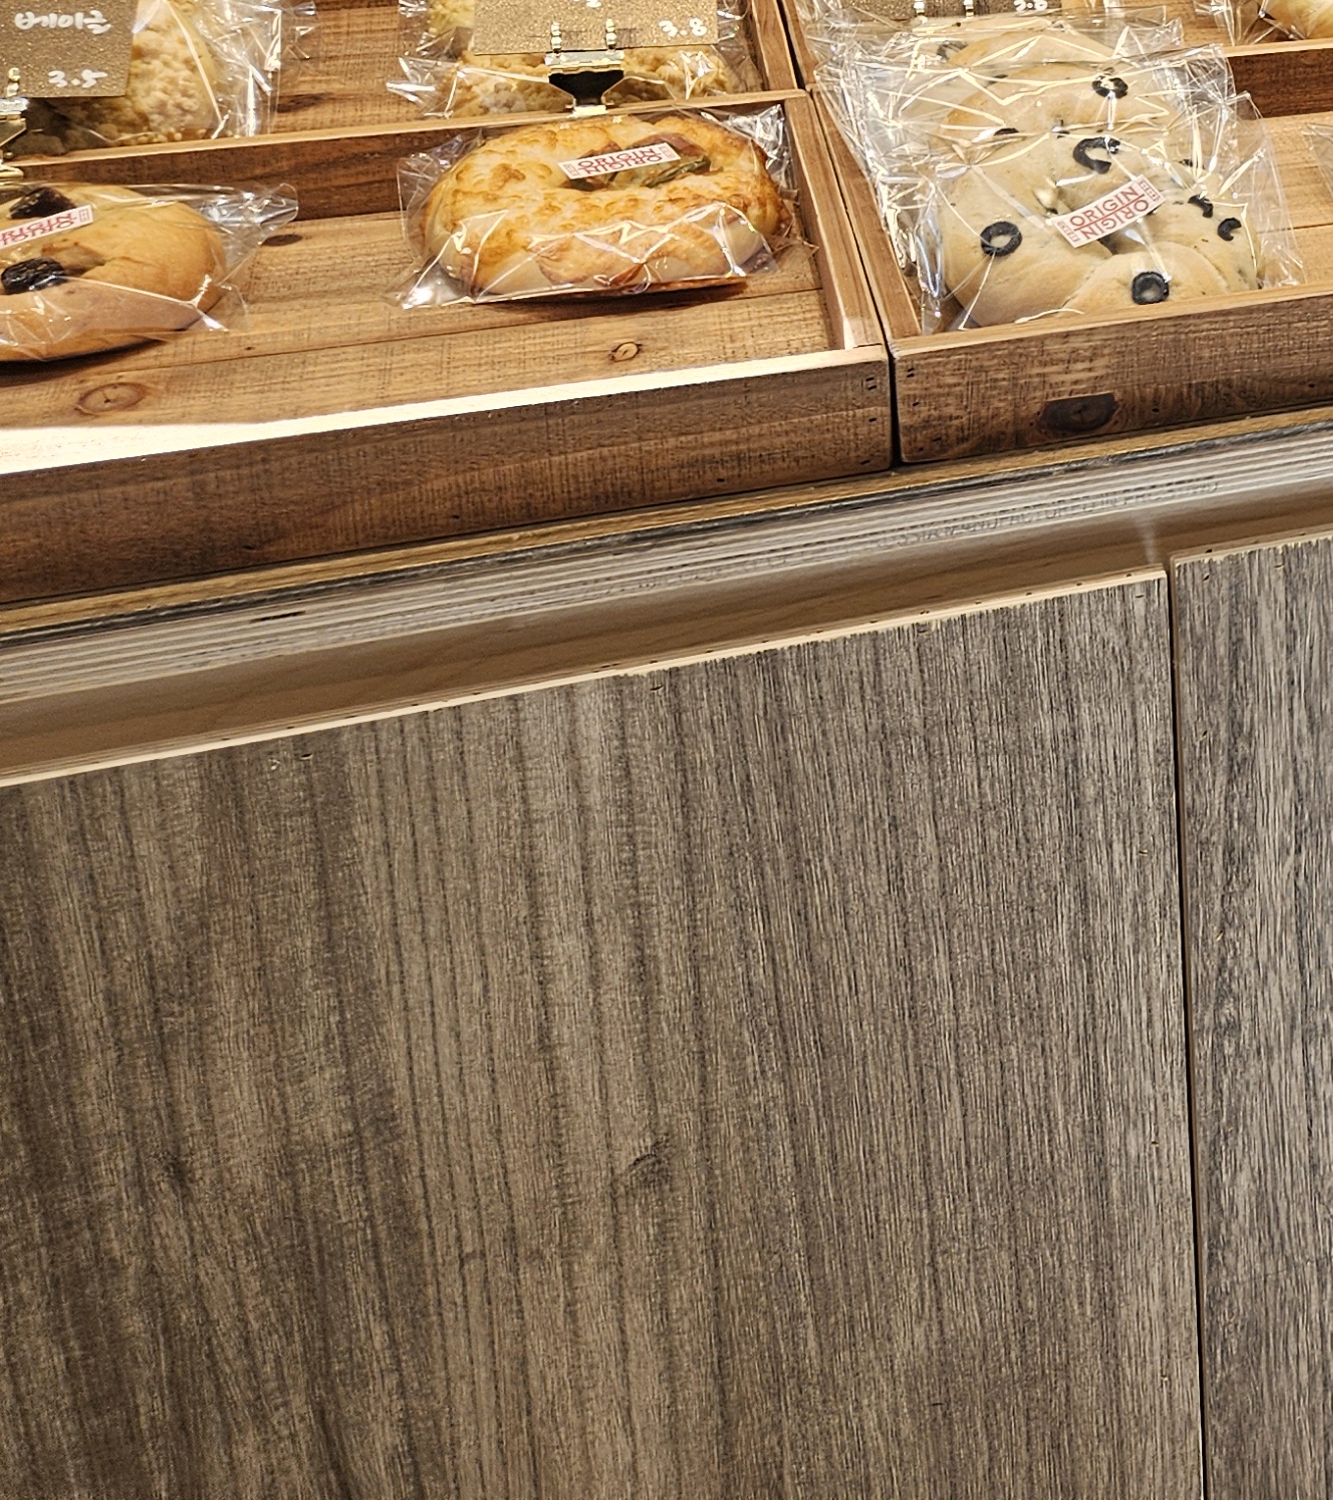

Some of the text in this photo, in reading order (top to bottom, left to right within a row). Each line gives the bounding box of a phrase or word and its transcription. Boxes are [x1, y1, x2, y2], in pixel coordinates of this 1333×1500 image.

[14, 9, 112, 35] 베이글
[657, 17, 708, 38] 3.8
[47, 69, 109, 89] 3.5
[577, 148, 658, 170] ORIGIN
[1069, 186, 1140, 227] ORIGIN
[1080, 199, 1150, 240] ORIGIN
